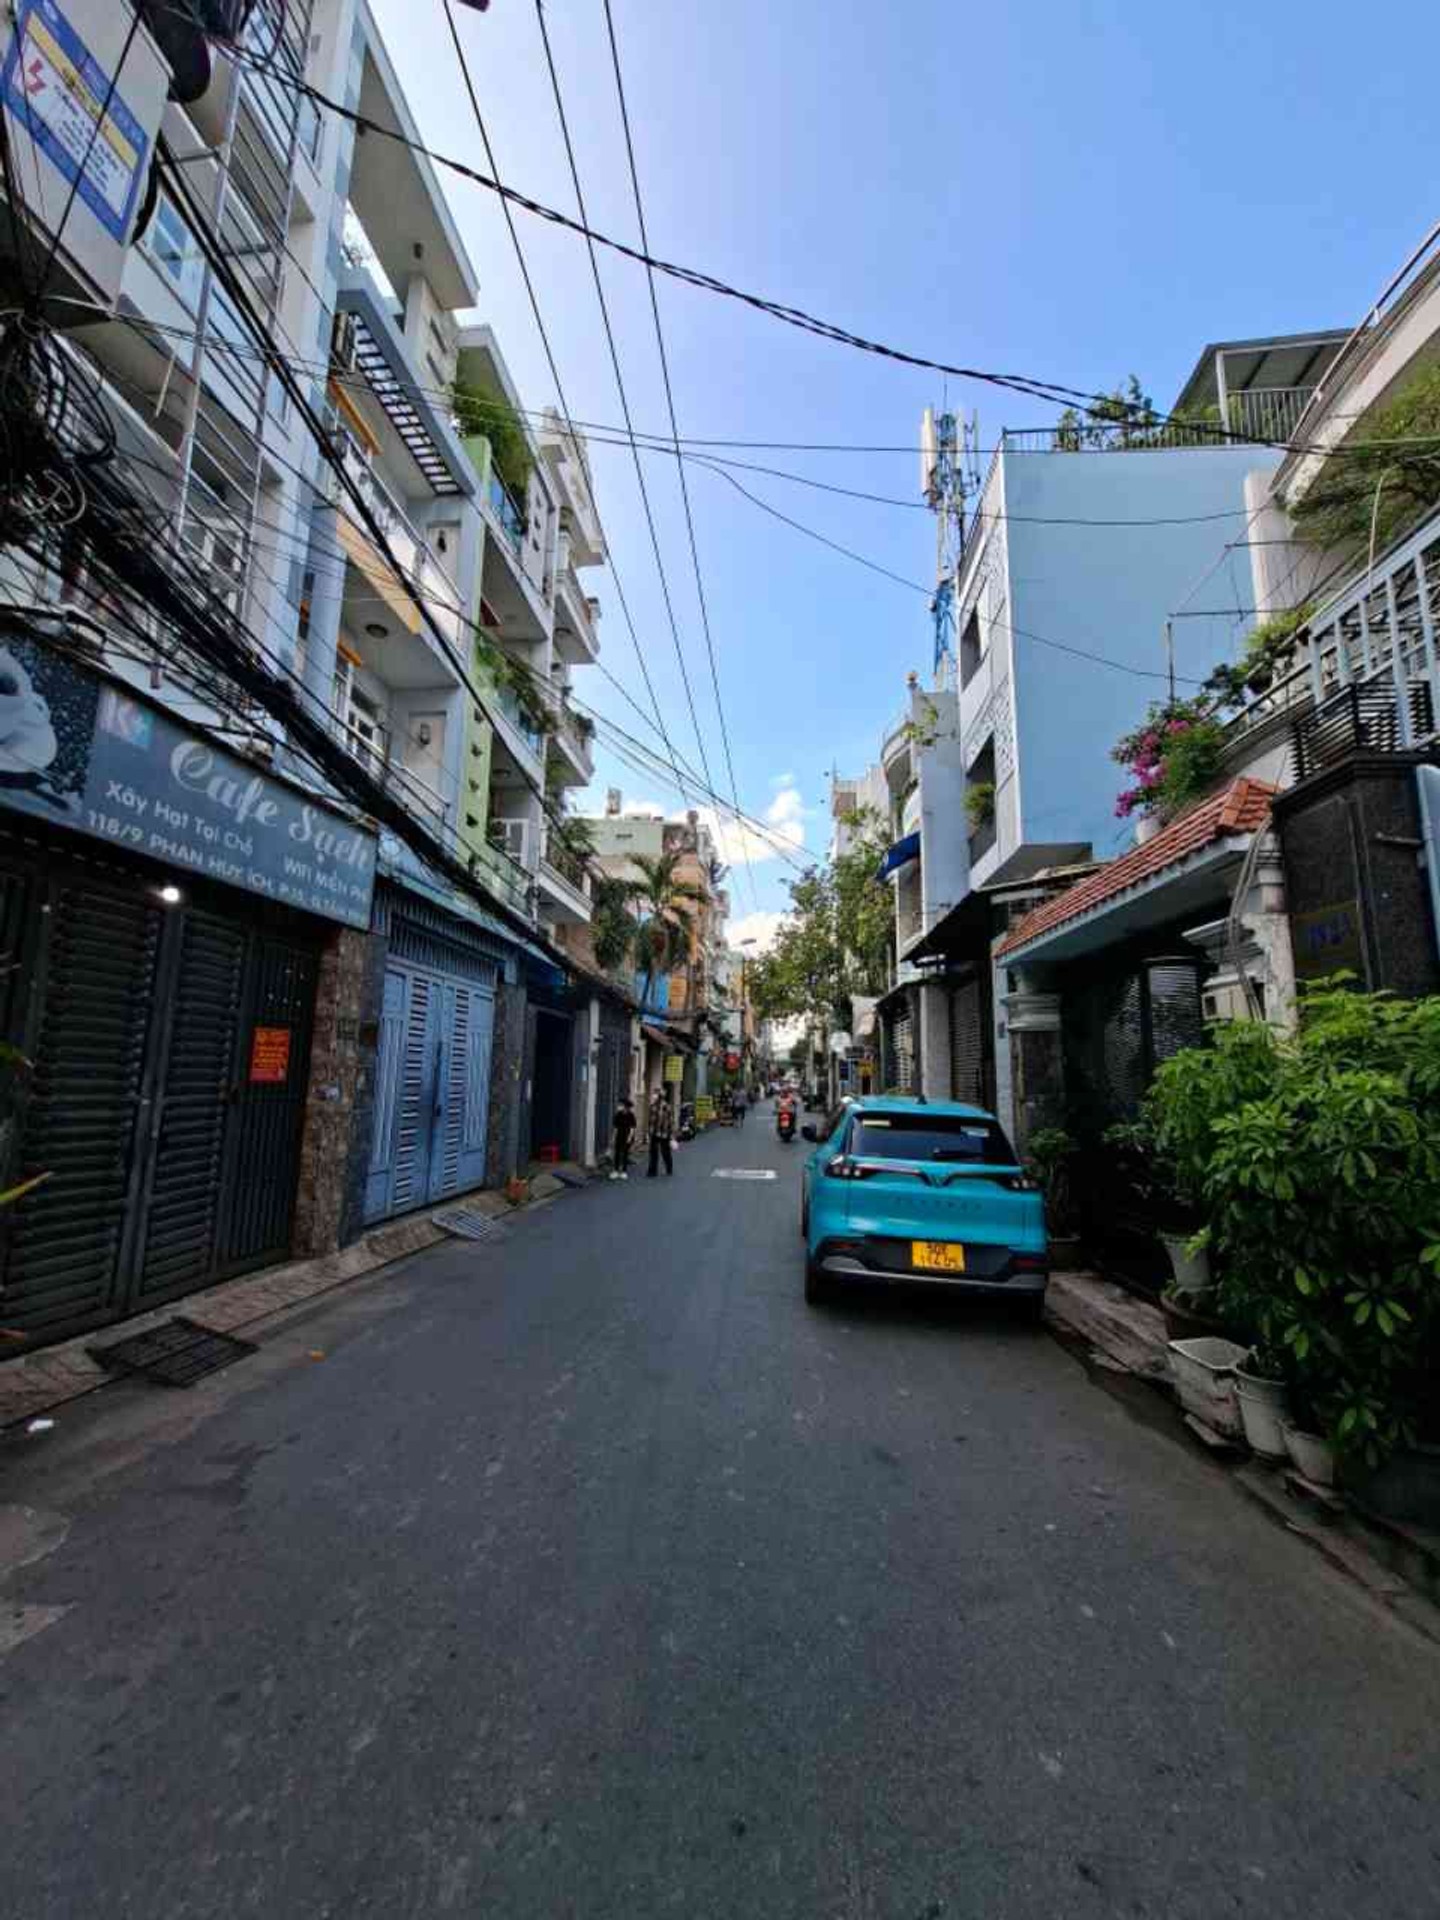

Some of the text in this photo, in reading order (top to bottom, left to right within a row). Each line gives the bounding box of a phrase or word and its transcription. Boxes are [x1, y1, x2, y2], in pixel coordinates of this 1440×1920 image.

[105, 780, 149, 813] Xây
[170, 741, 278, 826] Cafe
[88, 810, 143, 842] 118/9
